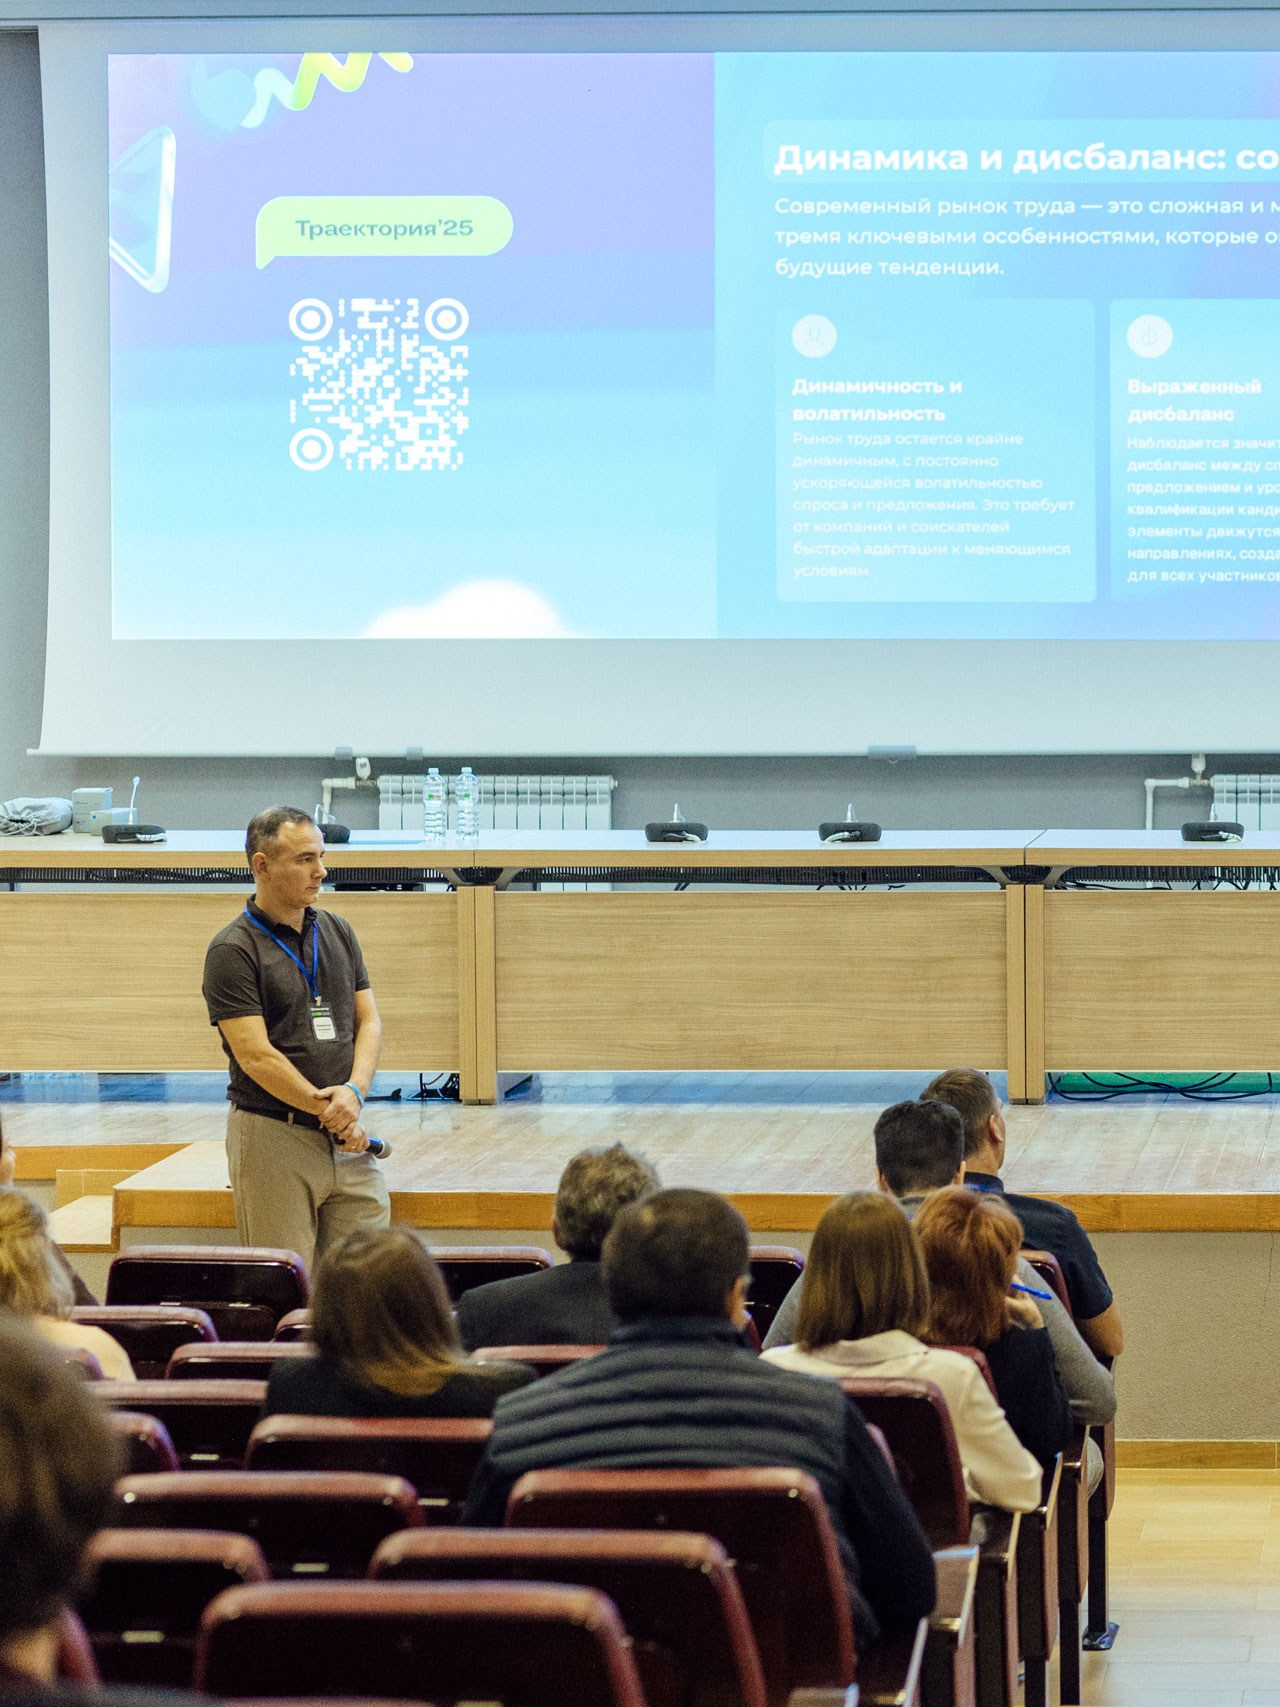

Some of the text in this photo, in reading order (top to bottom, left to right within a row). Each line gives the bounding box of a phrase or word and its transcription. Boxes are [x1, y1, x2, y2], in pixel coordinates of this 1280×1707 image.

[774, 145, 968, 175] Динамика
[981, 147, 1003, 169] и
[1013, 143, 1226, 174] дисбаланс:
[775, 197, 931, 217] Современный
[938, 199, 1007, 217] рынок
[1013, 199, 1075, 217] труда
[1108, 199, 1143, 214] это
[1149, 199, 1244, 214] сложная
[1251, 199, 1263, 214] и
[775, 230, 841, 247] тремя
[848, 230, 976, 244] ключевыми
[982, 227, 1160, 247] особенностями,
[1166, 230, 1259, 247] которые
[775, 258, 1005, 279] будущие тенденции.
[792, 379, 962, 395] Динамичность и
[1128, 379, 1262, 396] Выраженный
[793, 407, 946, 421] волатильность
[1128, 406, 1235, 423] дисбаланс
[793, 433, 1023, 448] Рынок труда остается крайне
[1127, 437, 1229, 451] Наблюдается
[792, 456, 999, 468] динамичным, с постоянно
[1127, 459, 1207, 473] дисбаланс
[1211, 460, 1261, 473] между
[793, 477, 1043, 491] ускоряющейся волатильностью
[1127, 482, 1240, 495] предложением
[1245, 483, 1253, 493] и
[793, 499, 1074, 514] спроса и предложения. Это требует
[1127, 503, 1234, 517] квалификации
[793, 521, 1010, 533] от компаний и соискателей
[1127, 527, 1202, 538] элементы
[1206, 527, 1280, 540] движутся
[793, 543, 1071, 558] быстрой адаптации к меняющимся
[1127, 549, 1237, 561] направлениях,
[1127, 571, 1157, 584] для
[1161, 571, 1195, 582] всех
